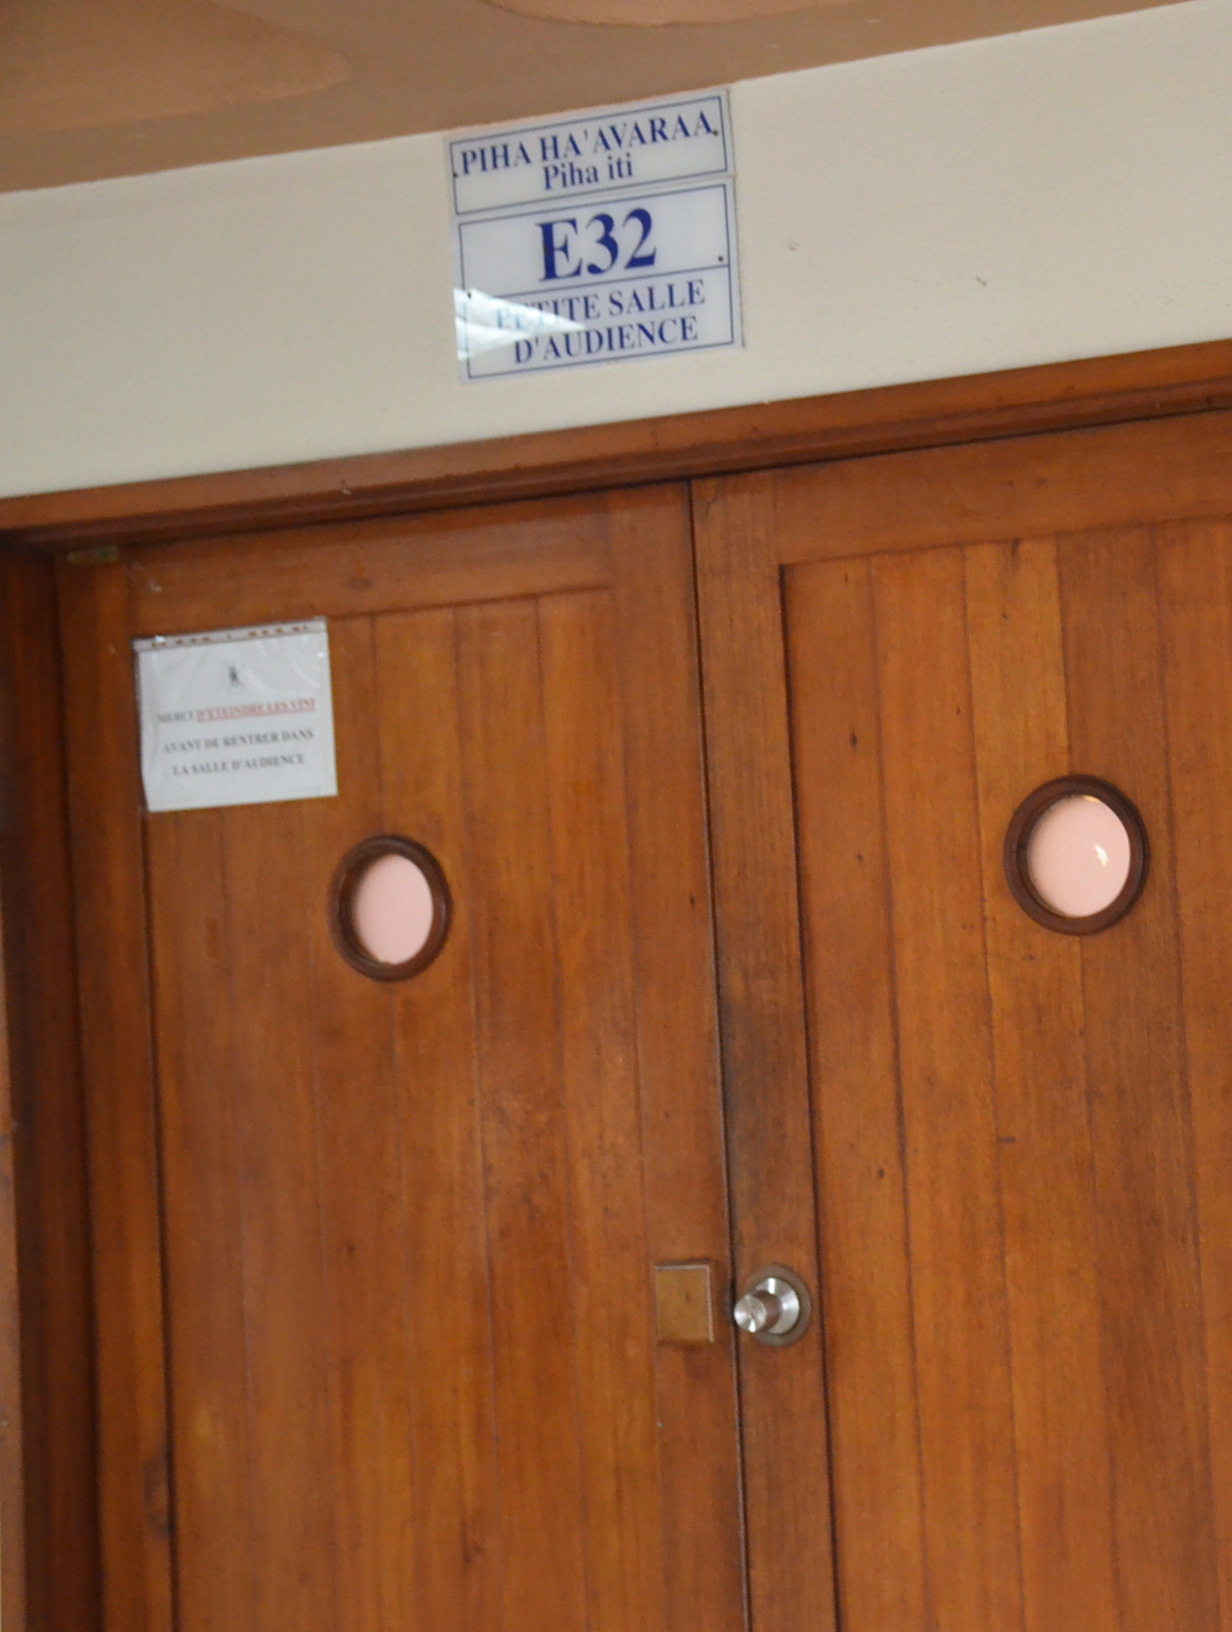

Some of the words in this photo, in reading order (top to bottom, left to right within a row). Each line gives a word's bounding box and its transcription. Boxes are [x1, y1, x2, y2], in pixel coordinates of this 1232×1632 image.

[461, 142, 532, 175] PIHA
[539, 110, 714, 162] HA'AVARAA
[543, 161, 599, 190] Piha
[608, 153, 633, 180] iti
[535, 207, 658, 283] E32
[608, 279, 706, 316] SALLE
[513, 315, 699, 364] D'AUDIENCE
[157, 709, 194, 723] MERCI
[163, 739, 202, 754] AVANT
[203, 737, 219, 750] DE
[222, 731, 279, 747] RENTRER
[281, 728, 315, 743] DANS
[172, 764, 190, 776] LA
[190, 760, 228, 774] SALLE
[231, 753, 305, 771] D'AUDIENCE
